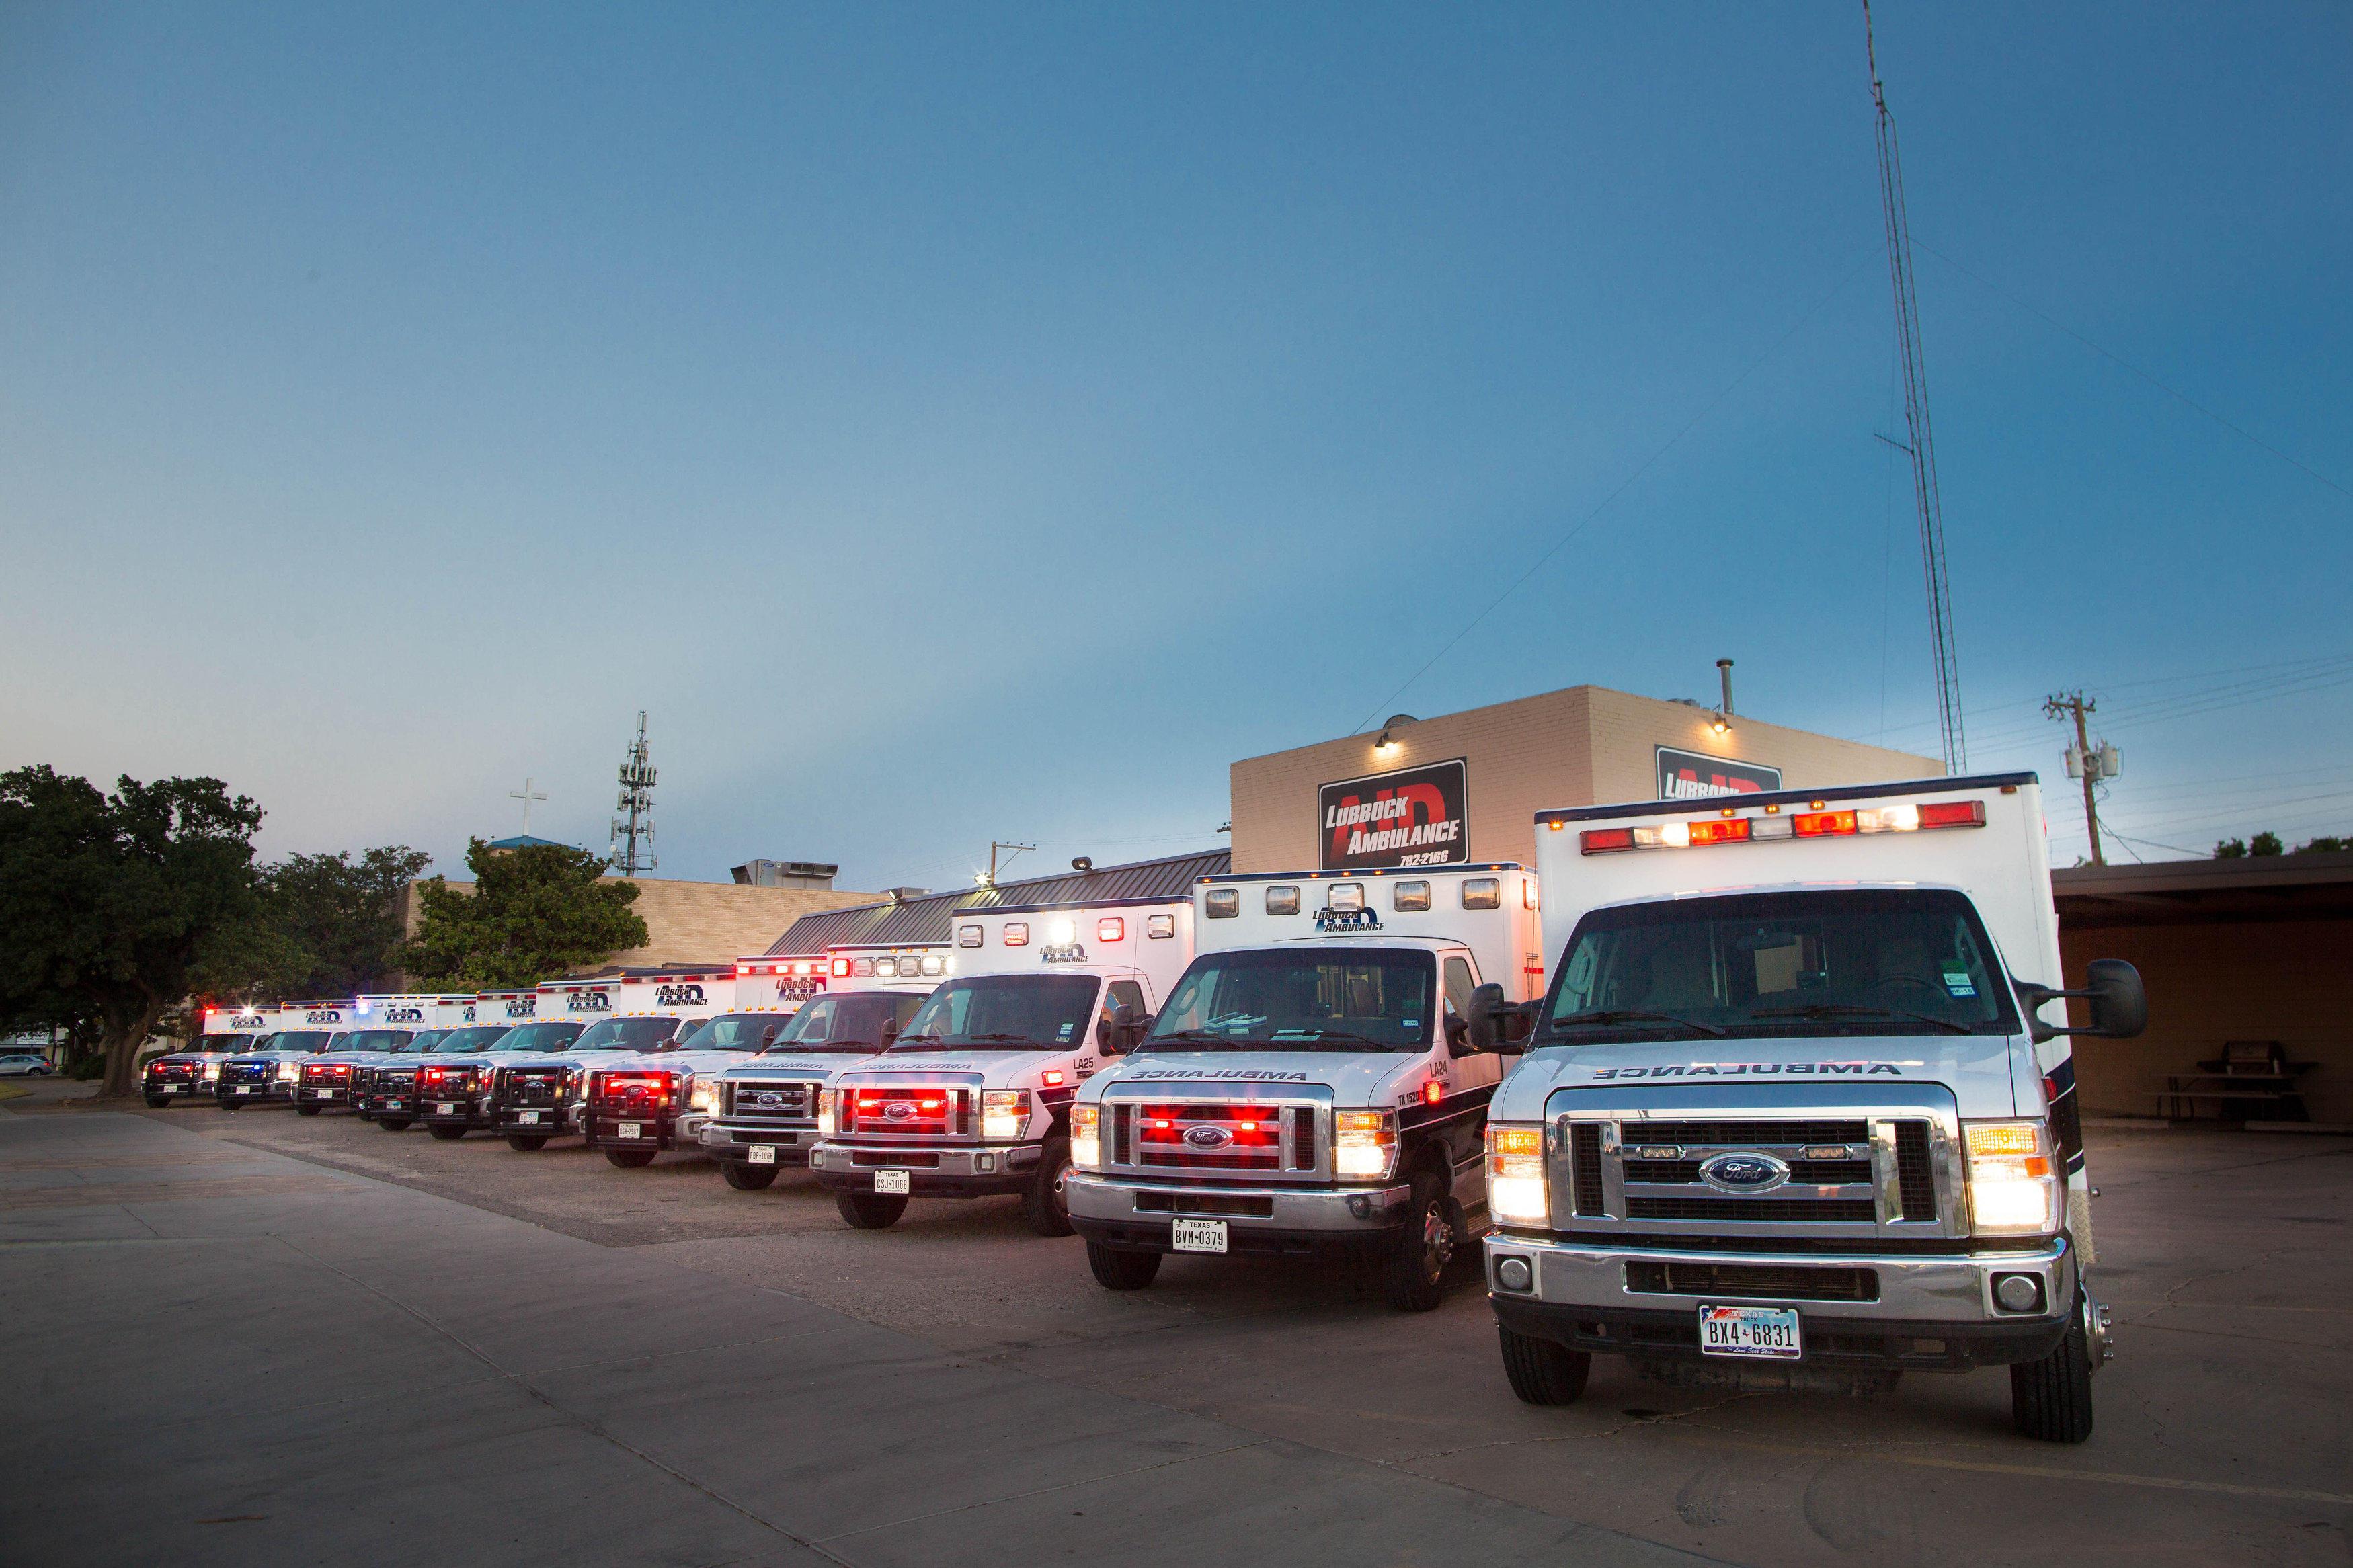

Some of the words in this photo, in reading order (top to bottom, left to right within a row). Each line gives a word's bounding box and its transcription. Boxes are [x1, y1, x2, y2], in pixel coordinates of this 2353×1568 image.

[1665, 772, 1739, 798] LUBBO
[1326, 796, 1409, 829] LUBBOCK
[1347, 819, 1460, 855] AMBULANCE
[1400, 850, 1449, 866] 792-2166
[1324, 922, 1384, 932] AMBULANCE
[1047, 955, 1089, 964] AMBULANCE
[776, 980, 815, 989] LUBBOCK
[655, 988, 690, 996] LUBBOCK
[1074, 1057, 1094, 1069] LA25
[1429, 1060, 1447, 1078] LA24
[1398, 1094, 1406, 1106] TX
[1195, 1131, 1216, 1143] Ford
[1723, 1163, 1762, 1180] Ford
